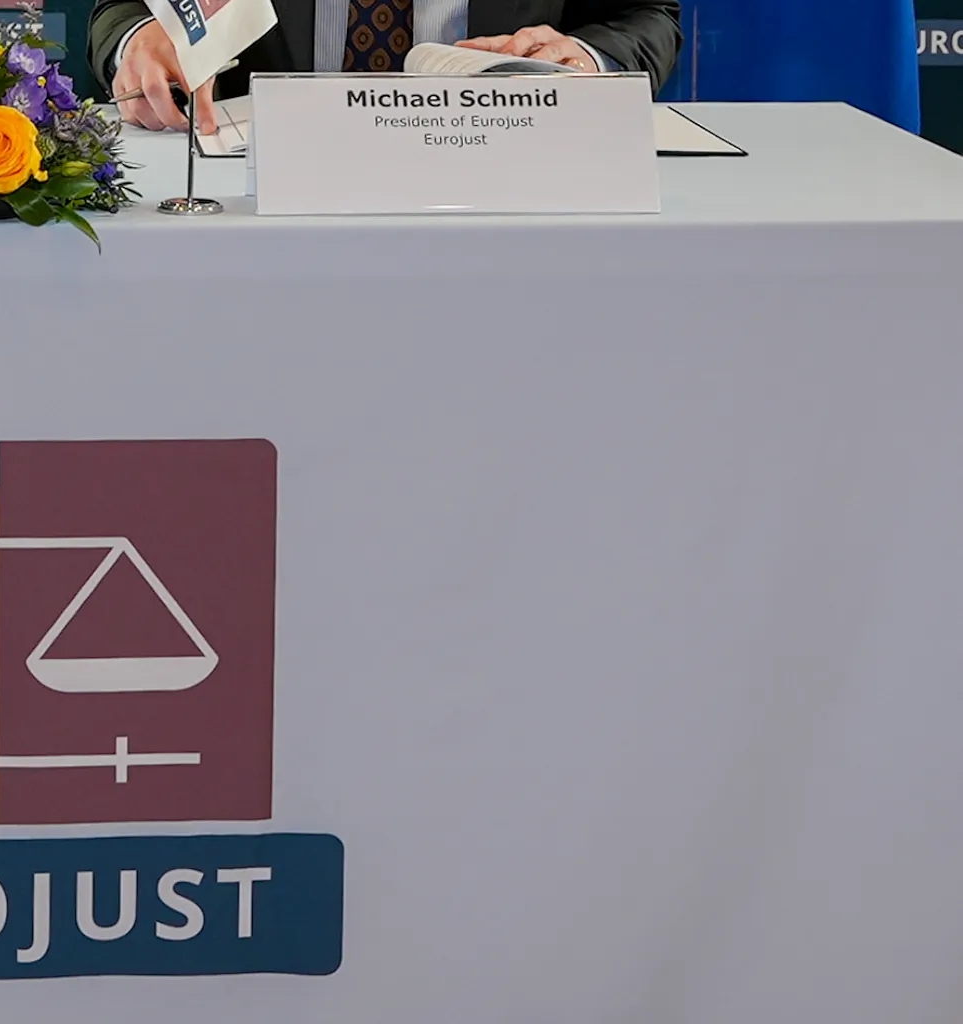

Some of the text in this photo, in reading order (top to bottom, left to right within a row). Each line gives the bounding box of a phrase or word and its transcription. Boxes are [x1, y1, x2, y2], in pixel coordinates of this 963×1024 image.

[347, 88, 558, 108] Michael Schmid
[374, 115, 534, 131] President of Eurojust
[424, 133, 487, 148] Eurojust
